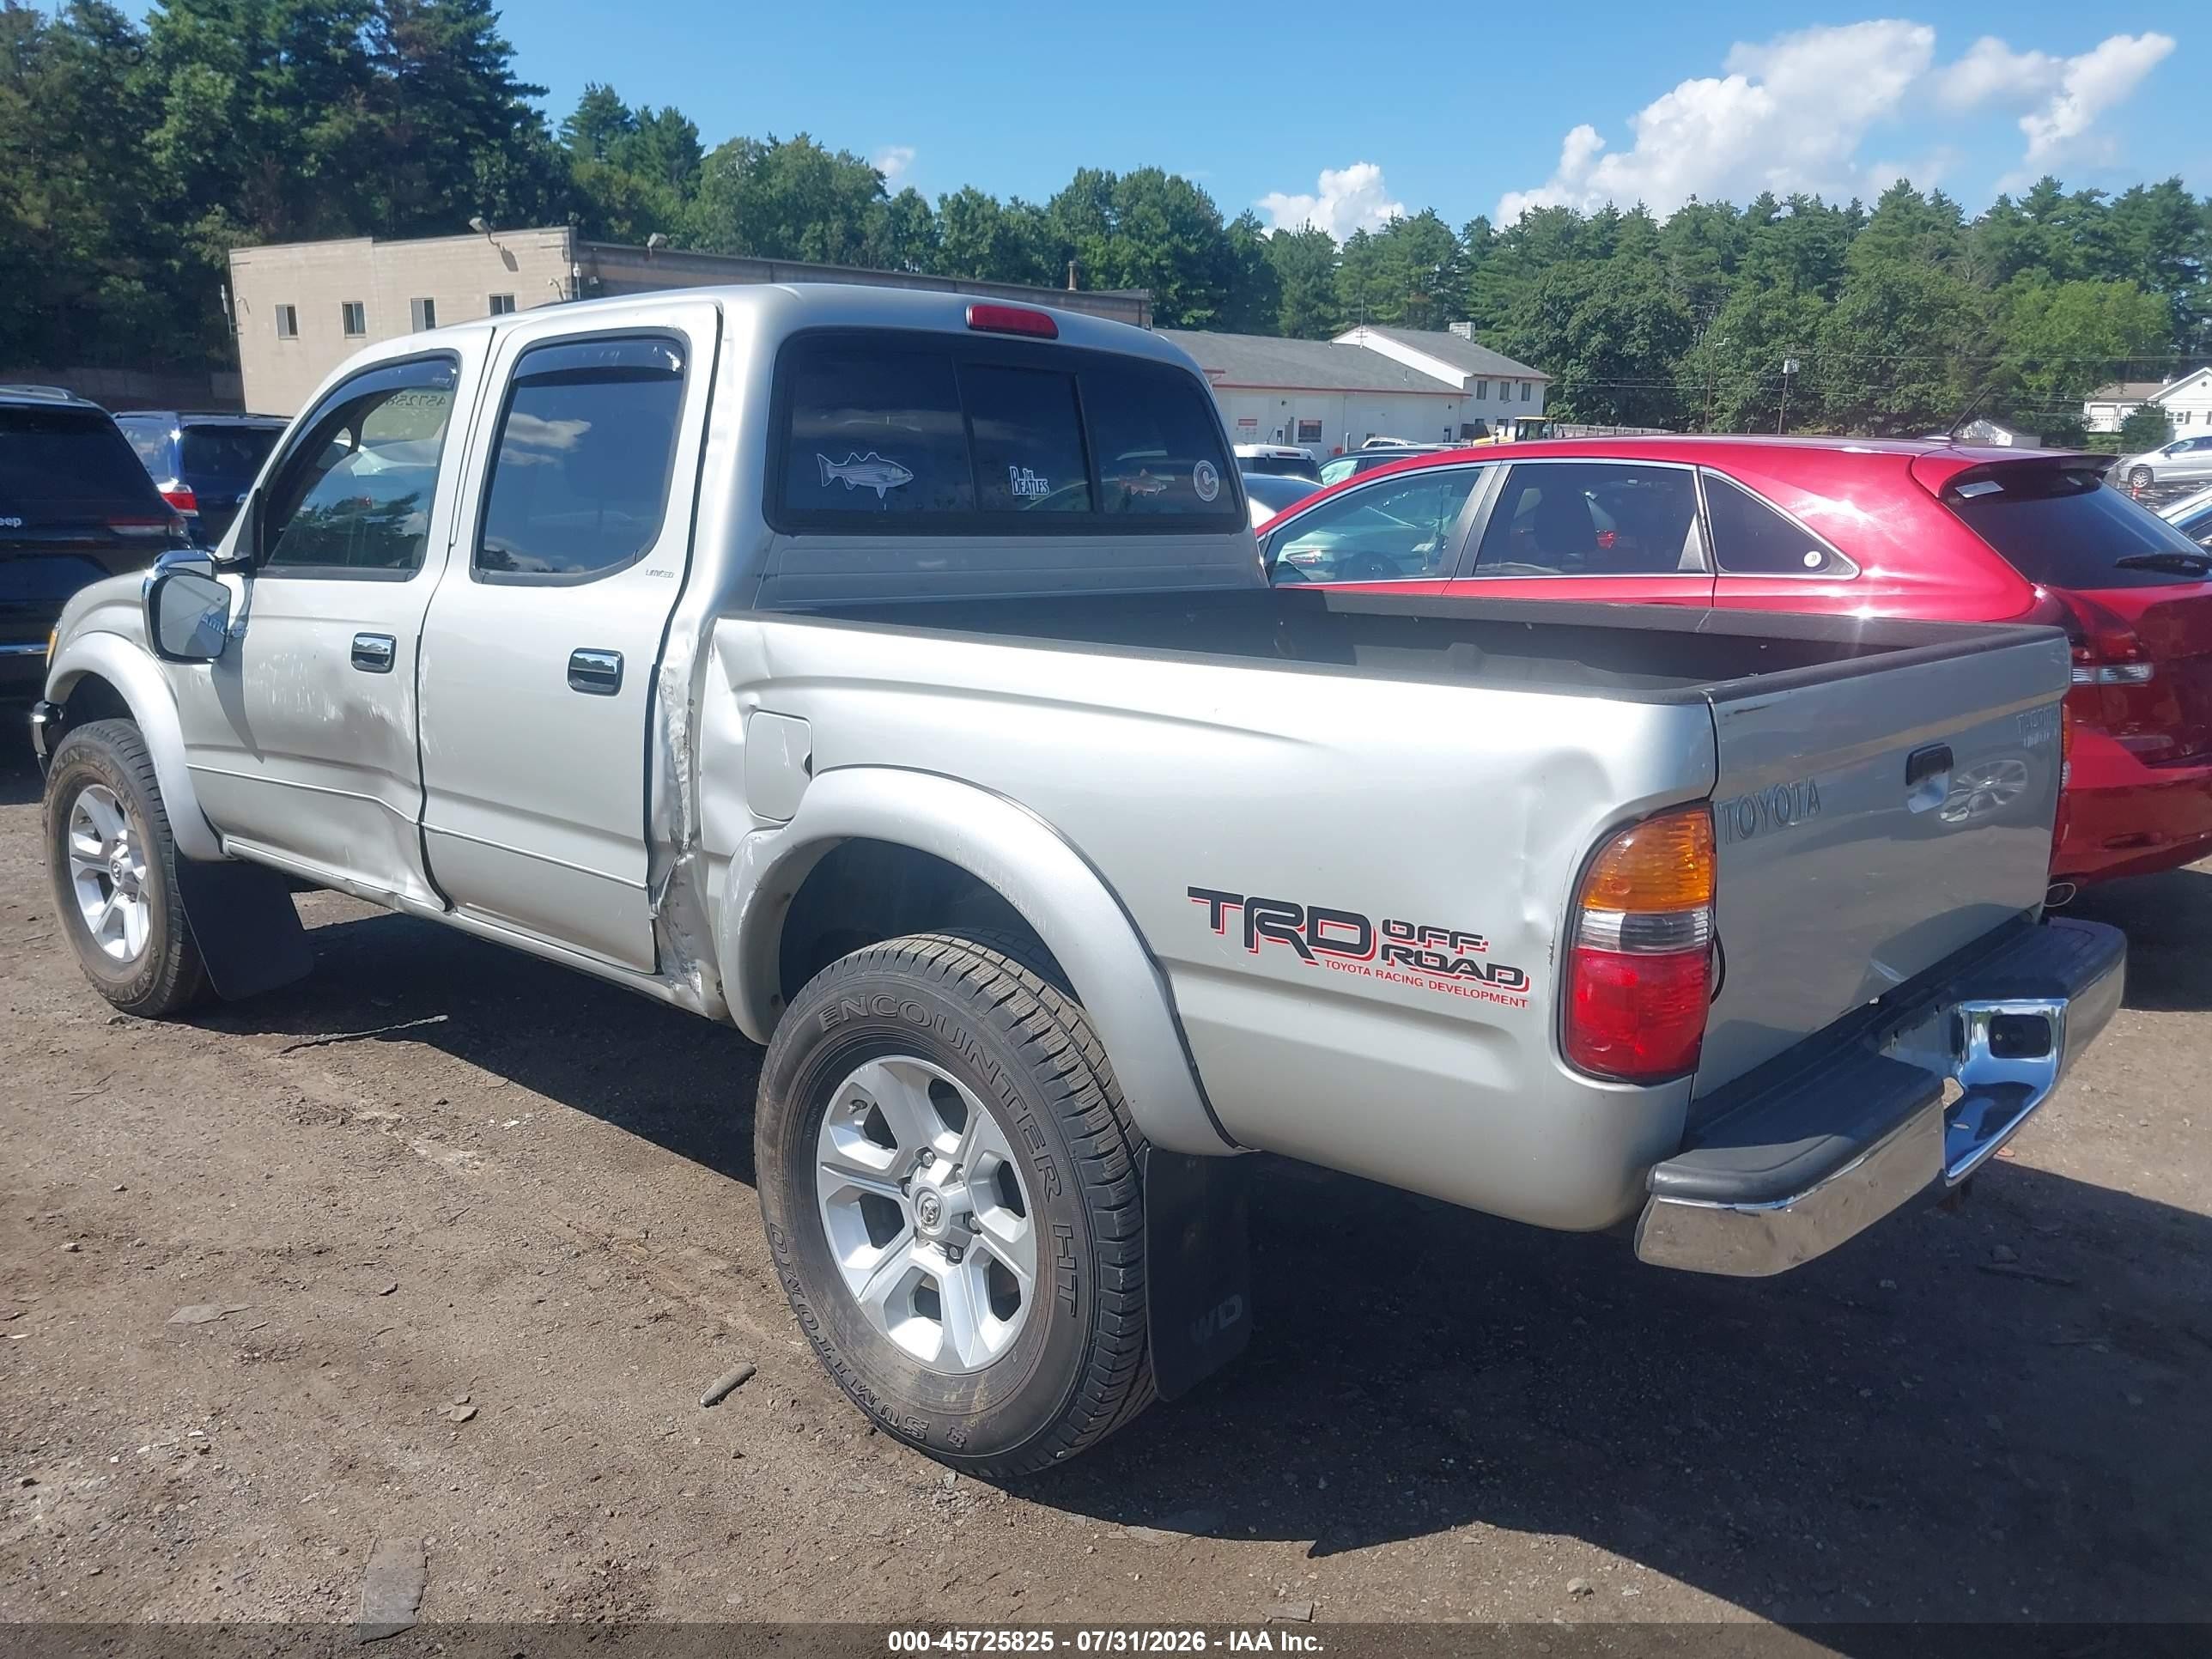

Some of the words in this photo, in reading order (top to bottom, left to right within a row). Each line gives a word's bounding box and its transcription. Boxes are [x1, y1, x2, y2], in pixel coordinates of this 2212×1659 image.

[1011, 467, 1049, 500] BEATLES
[0, 517, 21, 528] eep
[1718, 776, 1821, 845] TOYOTA
[1187, 885, 1376, 966] TRD
[1382, 919, 1489, 954] OFF
[1324, 959, 1372, 977] TOYOTA
[1376, 969, 1424, 988] RACING
[1428, 981, 1528, 1009] DEVELOPMENT
[1381, 944, 1530, 993] ROAD
[817, 994, 1062, 1202] ENCOUNTER
[1052, 1224, 1079, 1317] HT
